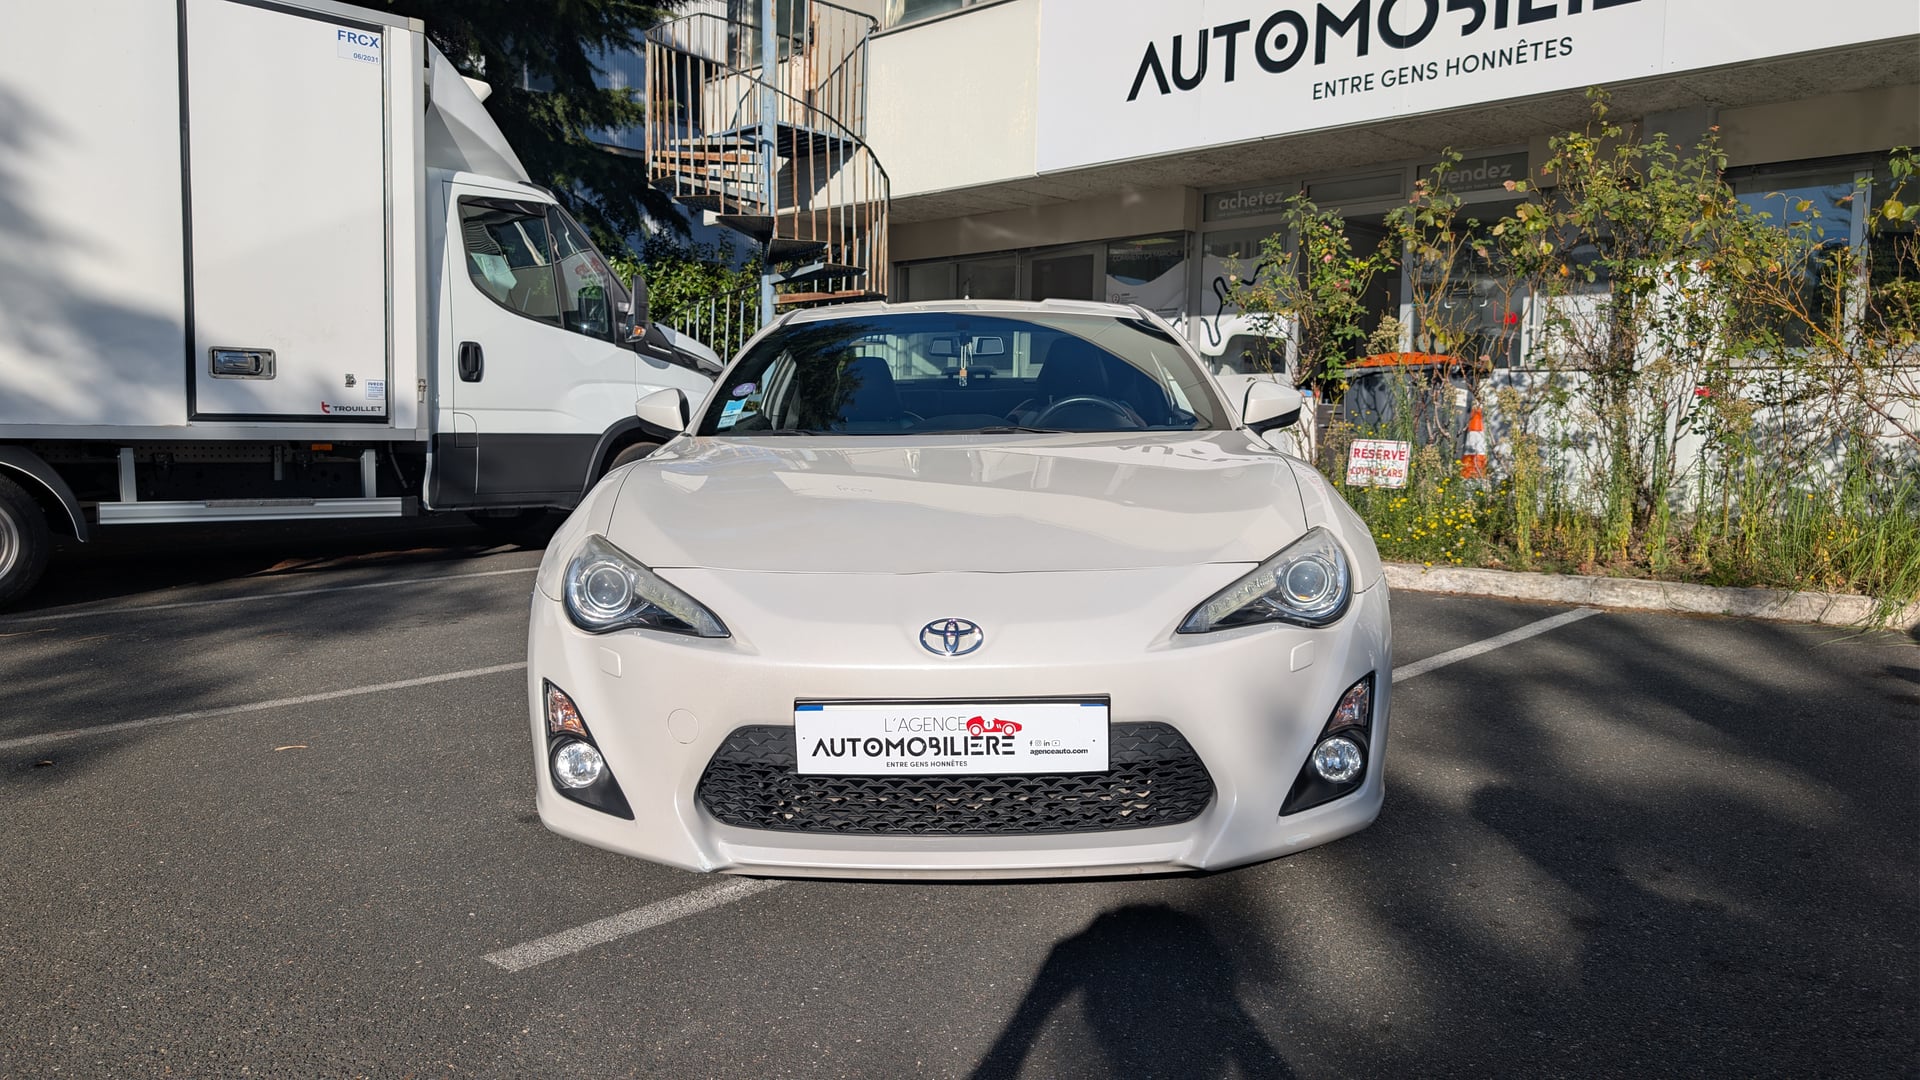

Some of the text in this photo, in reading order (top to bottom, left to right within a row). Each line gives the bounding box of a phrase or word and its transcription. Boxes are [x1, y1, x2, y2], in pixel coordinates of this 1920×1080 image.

[337, 30, 379, 48] FRCX
[353, 53, 379, 62] 06/2031
[1125, 0, 1642, 102] AUTOMOB
[1312, 36, 1574, 100] ENTRE GENS HONNÊTES
[1439, 159, 1512, 185] vendez
[1218, 190, 1284, 210] achetez
[1029, 748, 1089, 756] agenceauto.com
[910, 760, 929, 768] GENS
[930, 759, 968, 768] HONNÊTES
